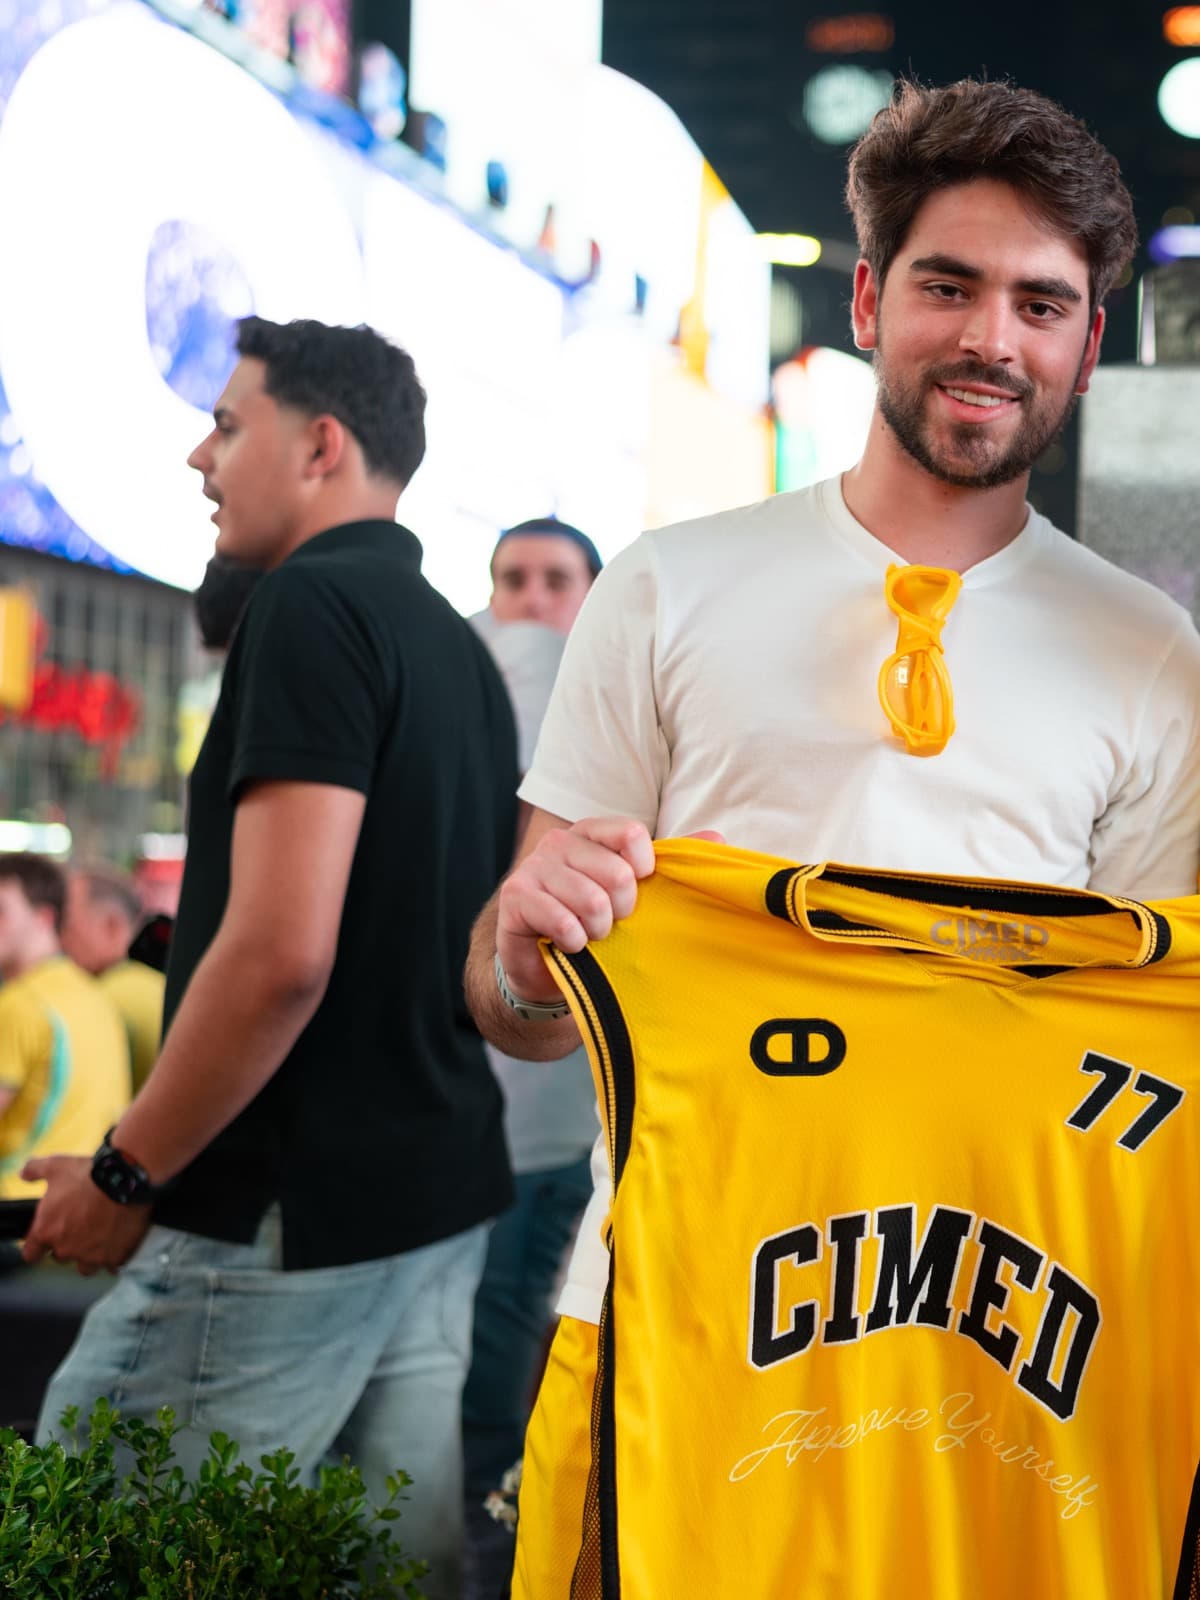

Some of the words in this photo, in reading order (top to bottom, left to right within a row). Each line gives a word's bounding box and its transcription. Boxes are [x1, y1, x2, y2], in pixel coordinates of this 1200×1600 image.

[930, 916, 1050, 948] CIMED
[1064, 1049, 1188, 1154] 77
[747, 1202, 1103, 1424] CIMED
[933, 1391, 1100, 1520] Yourself
